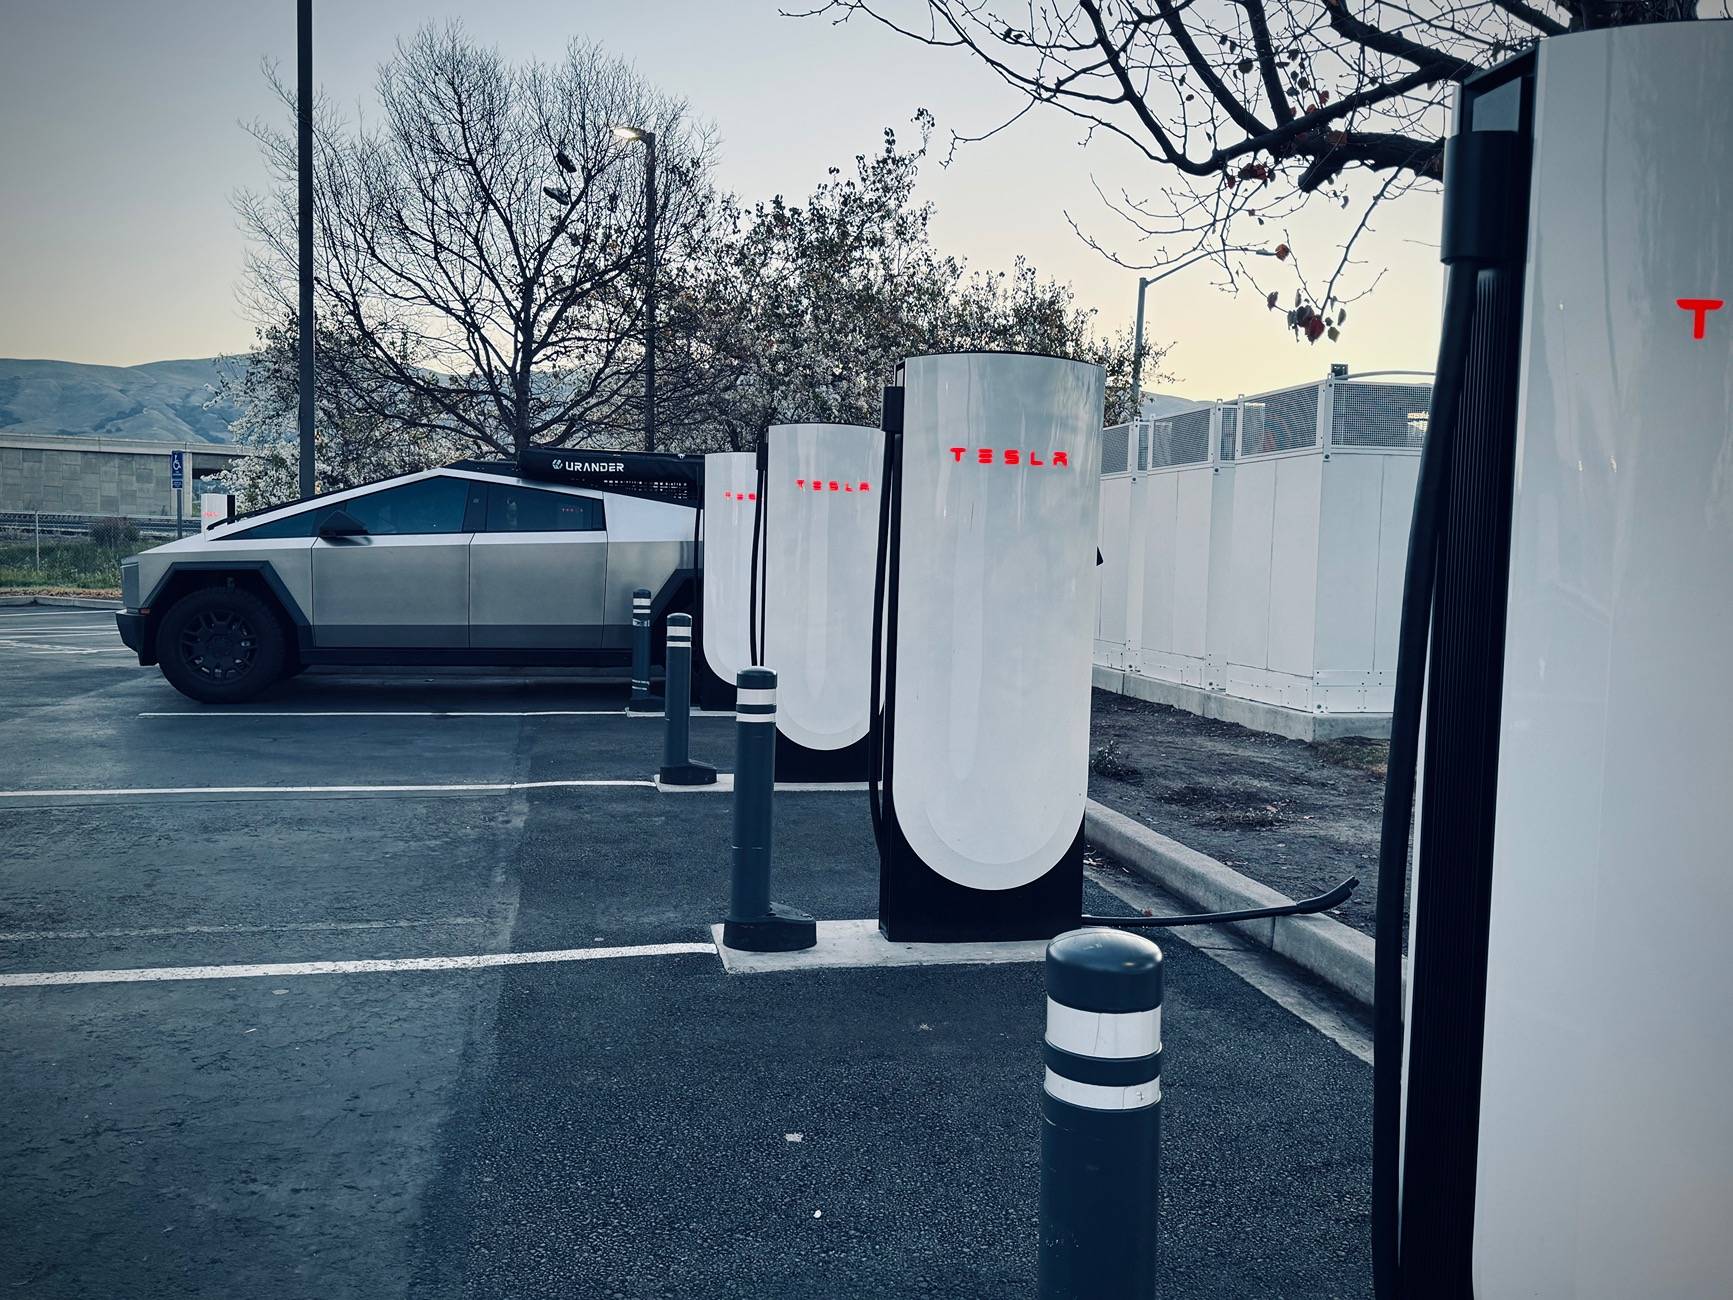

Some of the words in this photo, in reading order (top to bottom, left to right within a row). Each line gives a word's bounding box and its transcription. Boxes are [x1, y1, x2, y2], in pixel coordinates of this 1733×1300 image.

[949, 447, 1069, 467] TESLA
[565, 461, 625, 472] URANDER
[796, 479, 871, 492] TESLA
